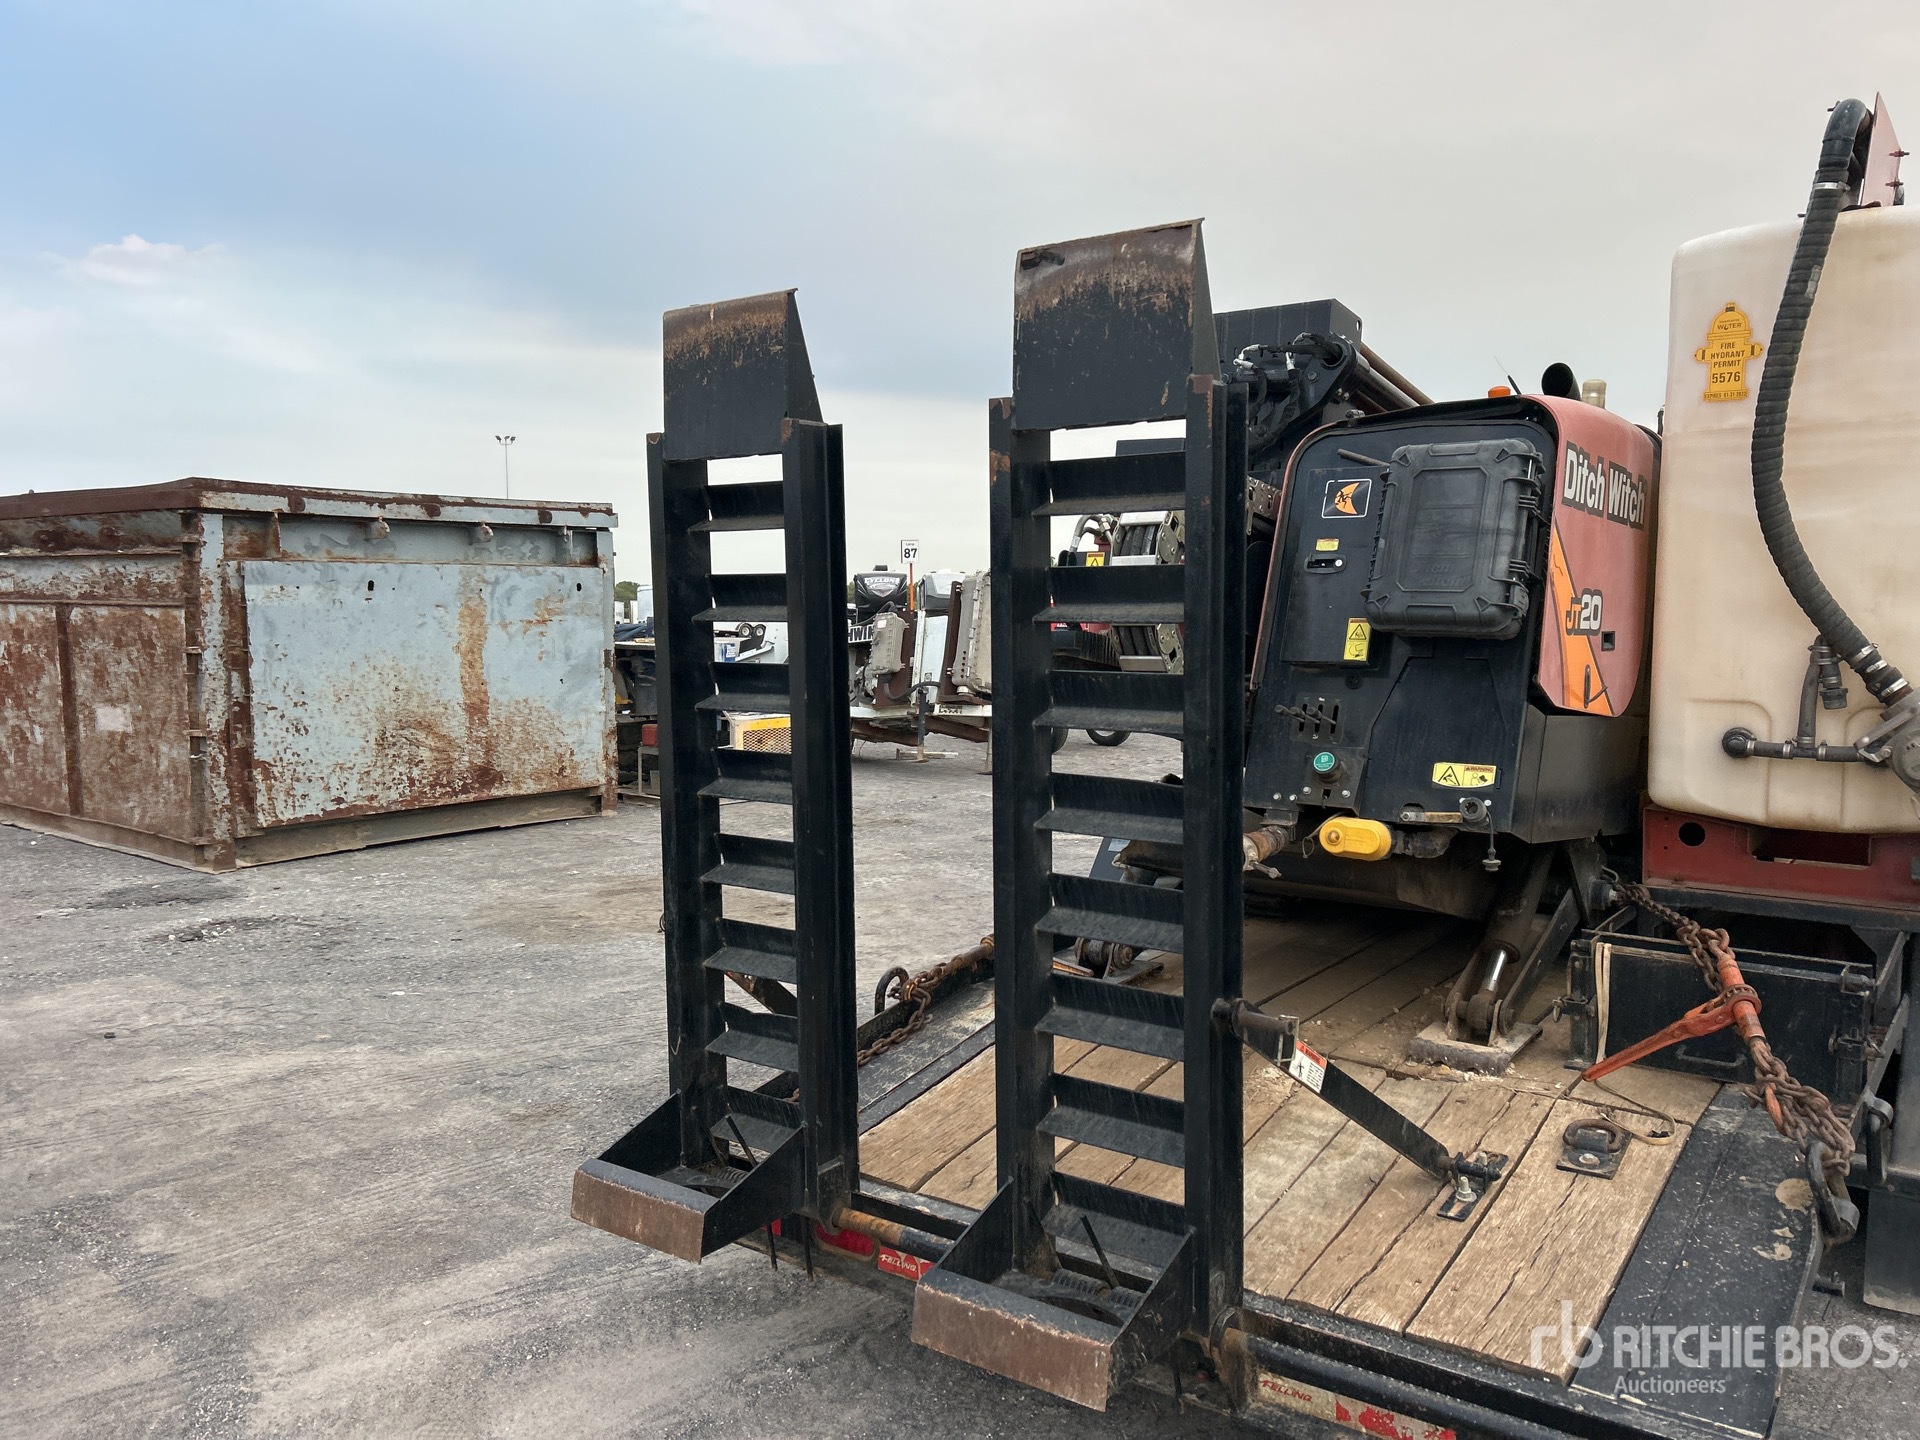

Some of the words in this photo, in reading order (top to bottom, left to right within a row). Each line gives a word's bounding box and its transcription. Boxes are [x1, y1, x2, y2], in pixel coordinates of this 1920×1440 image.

[1720, 341, 1736, 349] FIRE
[1710, 350, 1746, 360] HYDRANT
[1713, 360, 1742, 368] PERMIT
[1712, 371, 1741, 384] 5576
[1563, 448, 1606, 512] Ditch
[1608, 467, 1646, 527] Witch
[903, 547, 918, 559] 87
[1566, 592, 1603, 632] JT20
[1259, 1378, 1313, 1403] FELLING
